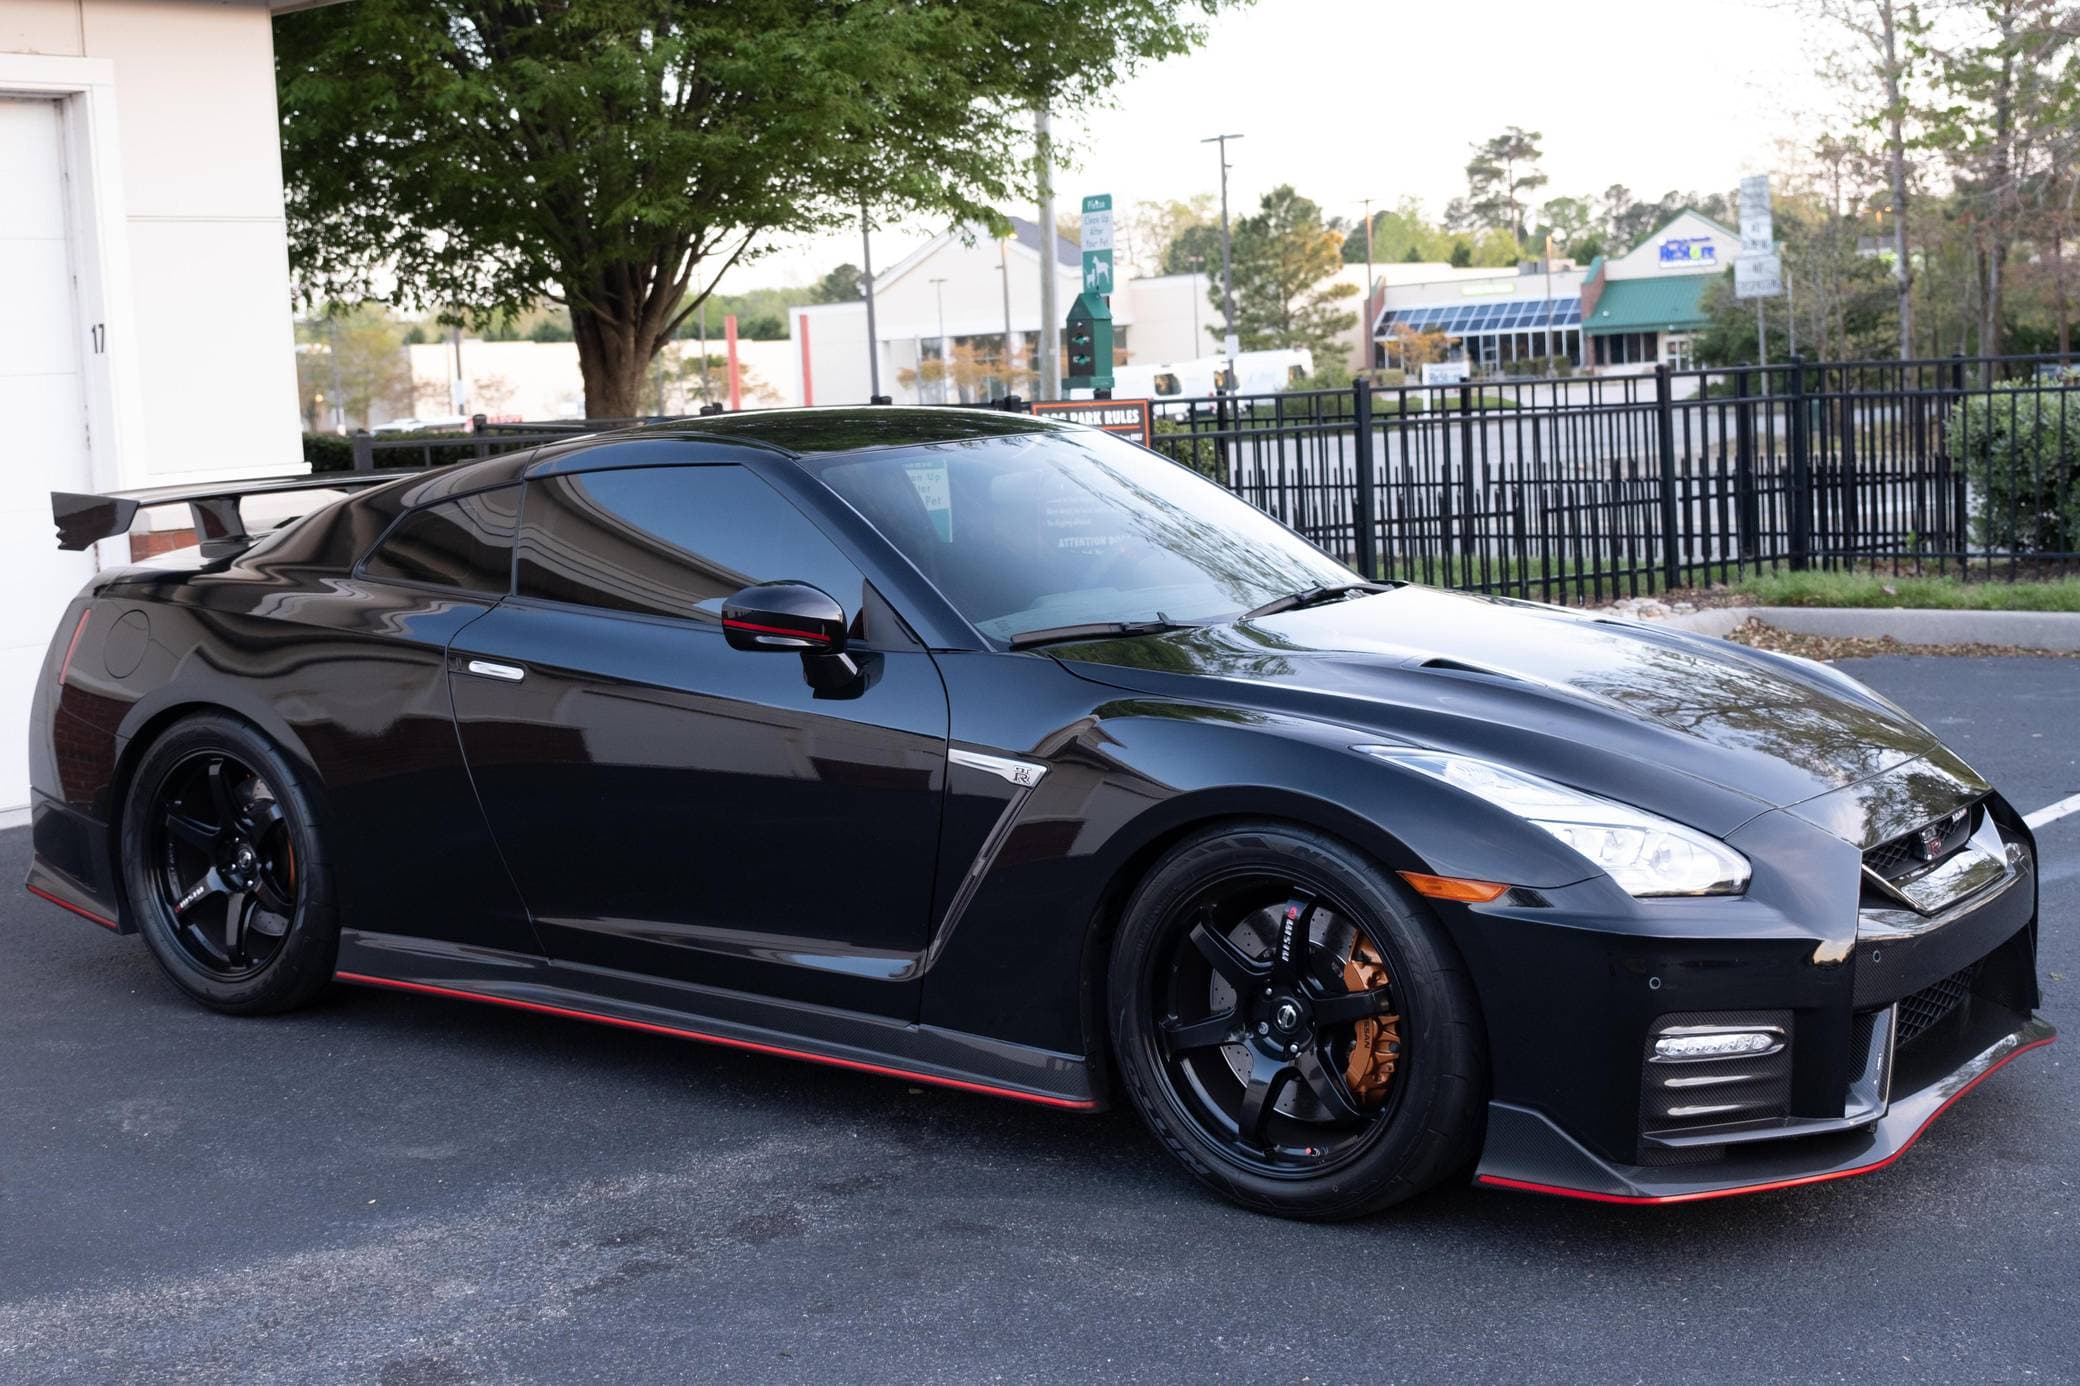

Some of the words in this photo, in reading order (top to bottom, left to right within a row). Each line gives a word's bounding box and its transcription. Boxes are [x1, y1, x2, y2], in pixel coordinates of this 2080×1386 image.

[91, 323, 104, 354] 17
[1070, 410, 1102, 425] PARK
[1104, 409, 1140, 424] RULES
